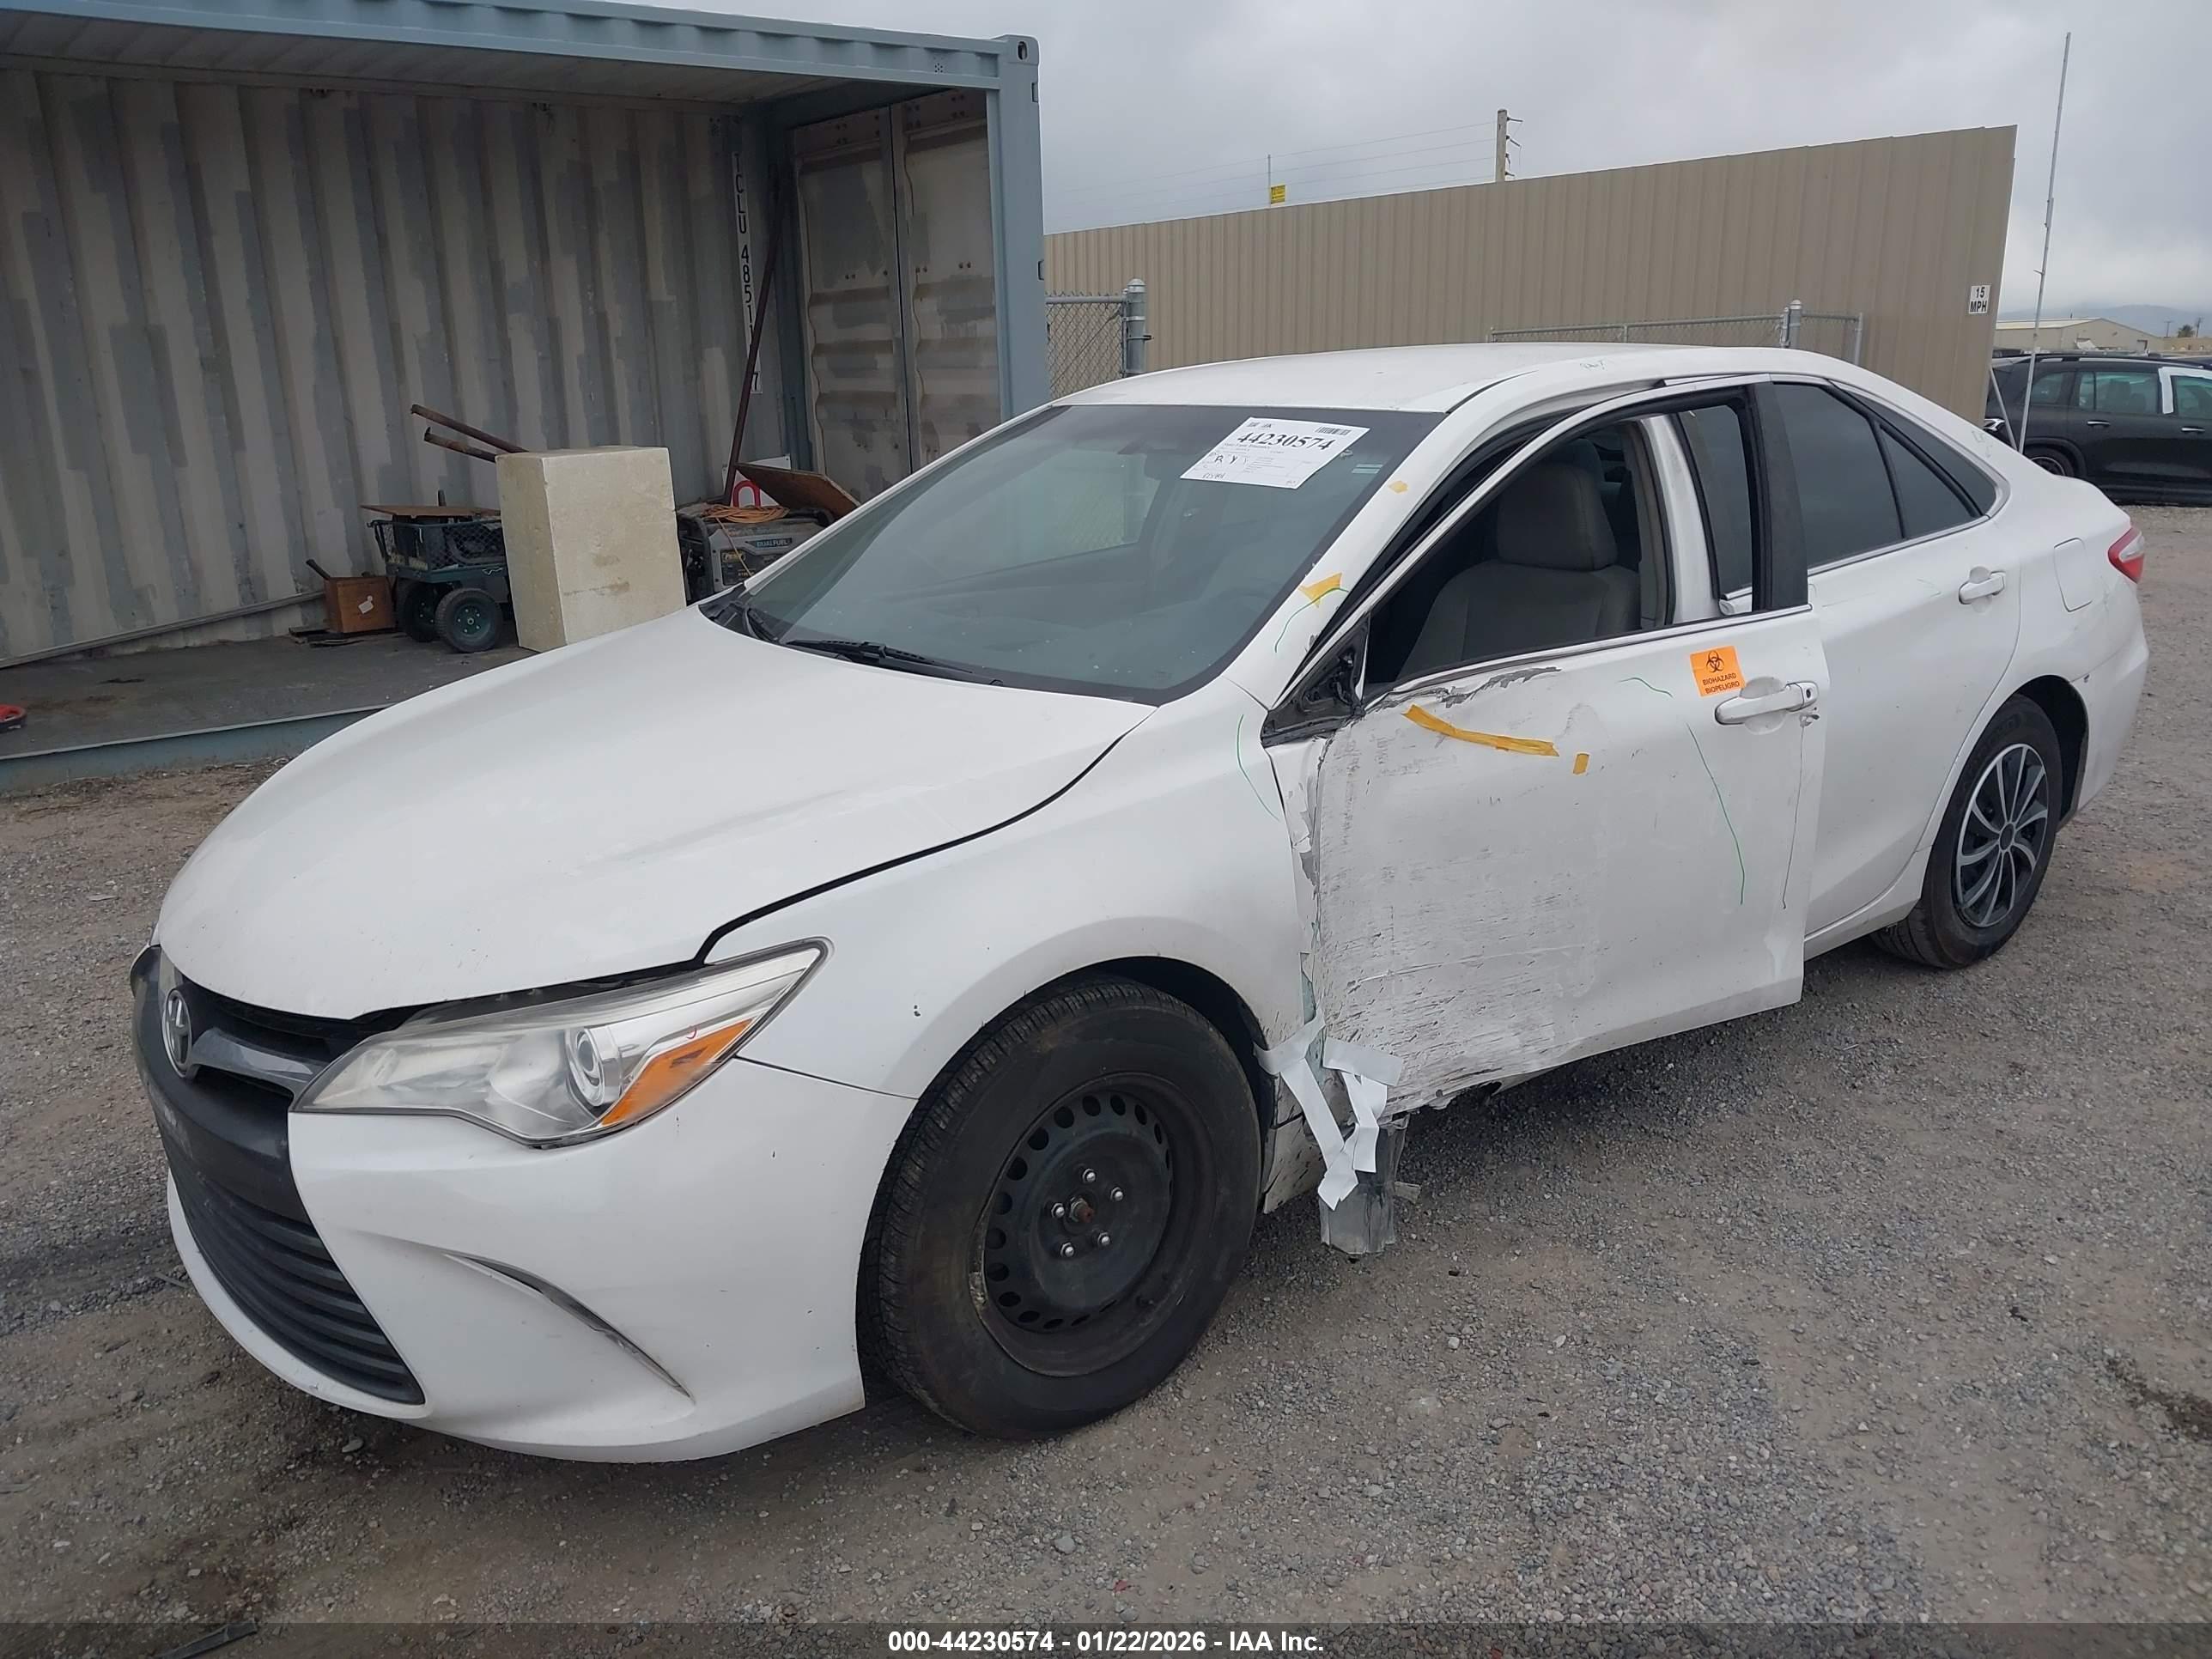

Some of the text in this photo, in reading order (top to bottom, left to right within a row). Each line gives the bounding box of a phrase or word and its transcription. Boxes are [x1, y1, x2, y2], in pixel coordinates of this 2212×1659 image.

[733, 154, 747, 234] TCLU
[1976, 286, 1985, 298] 15
[1970, 301, 1987, 313] MPH
[1237, 432, 1336, 450] 44230574
[1702, 673, 1737, 685] BIOHAZARD
[1705, 681, 1741, 694] BIOPELIGRO
